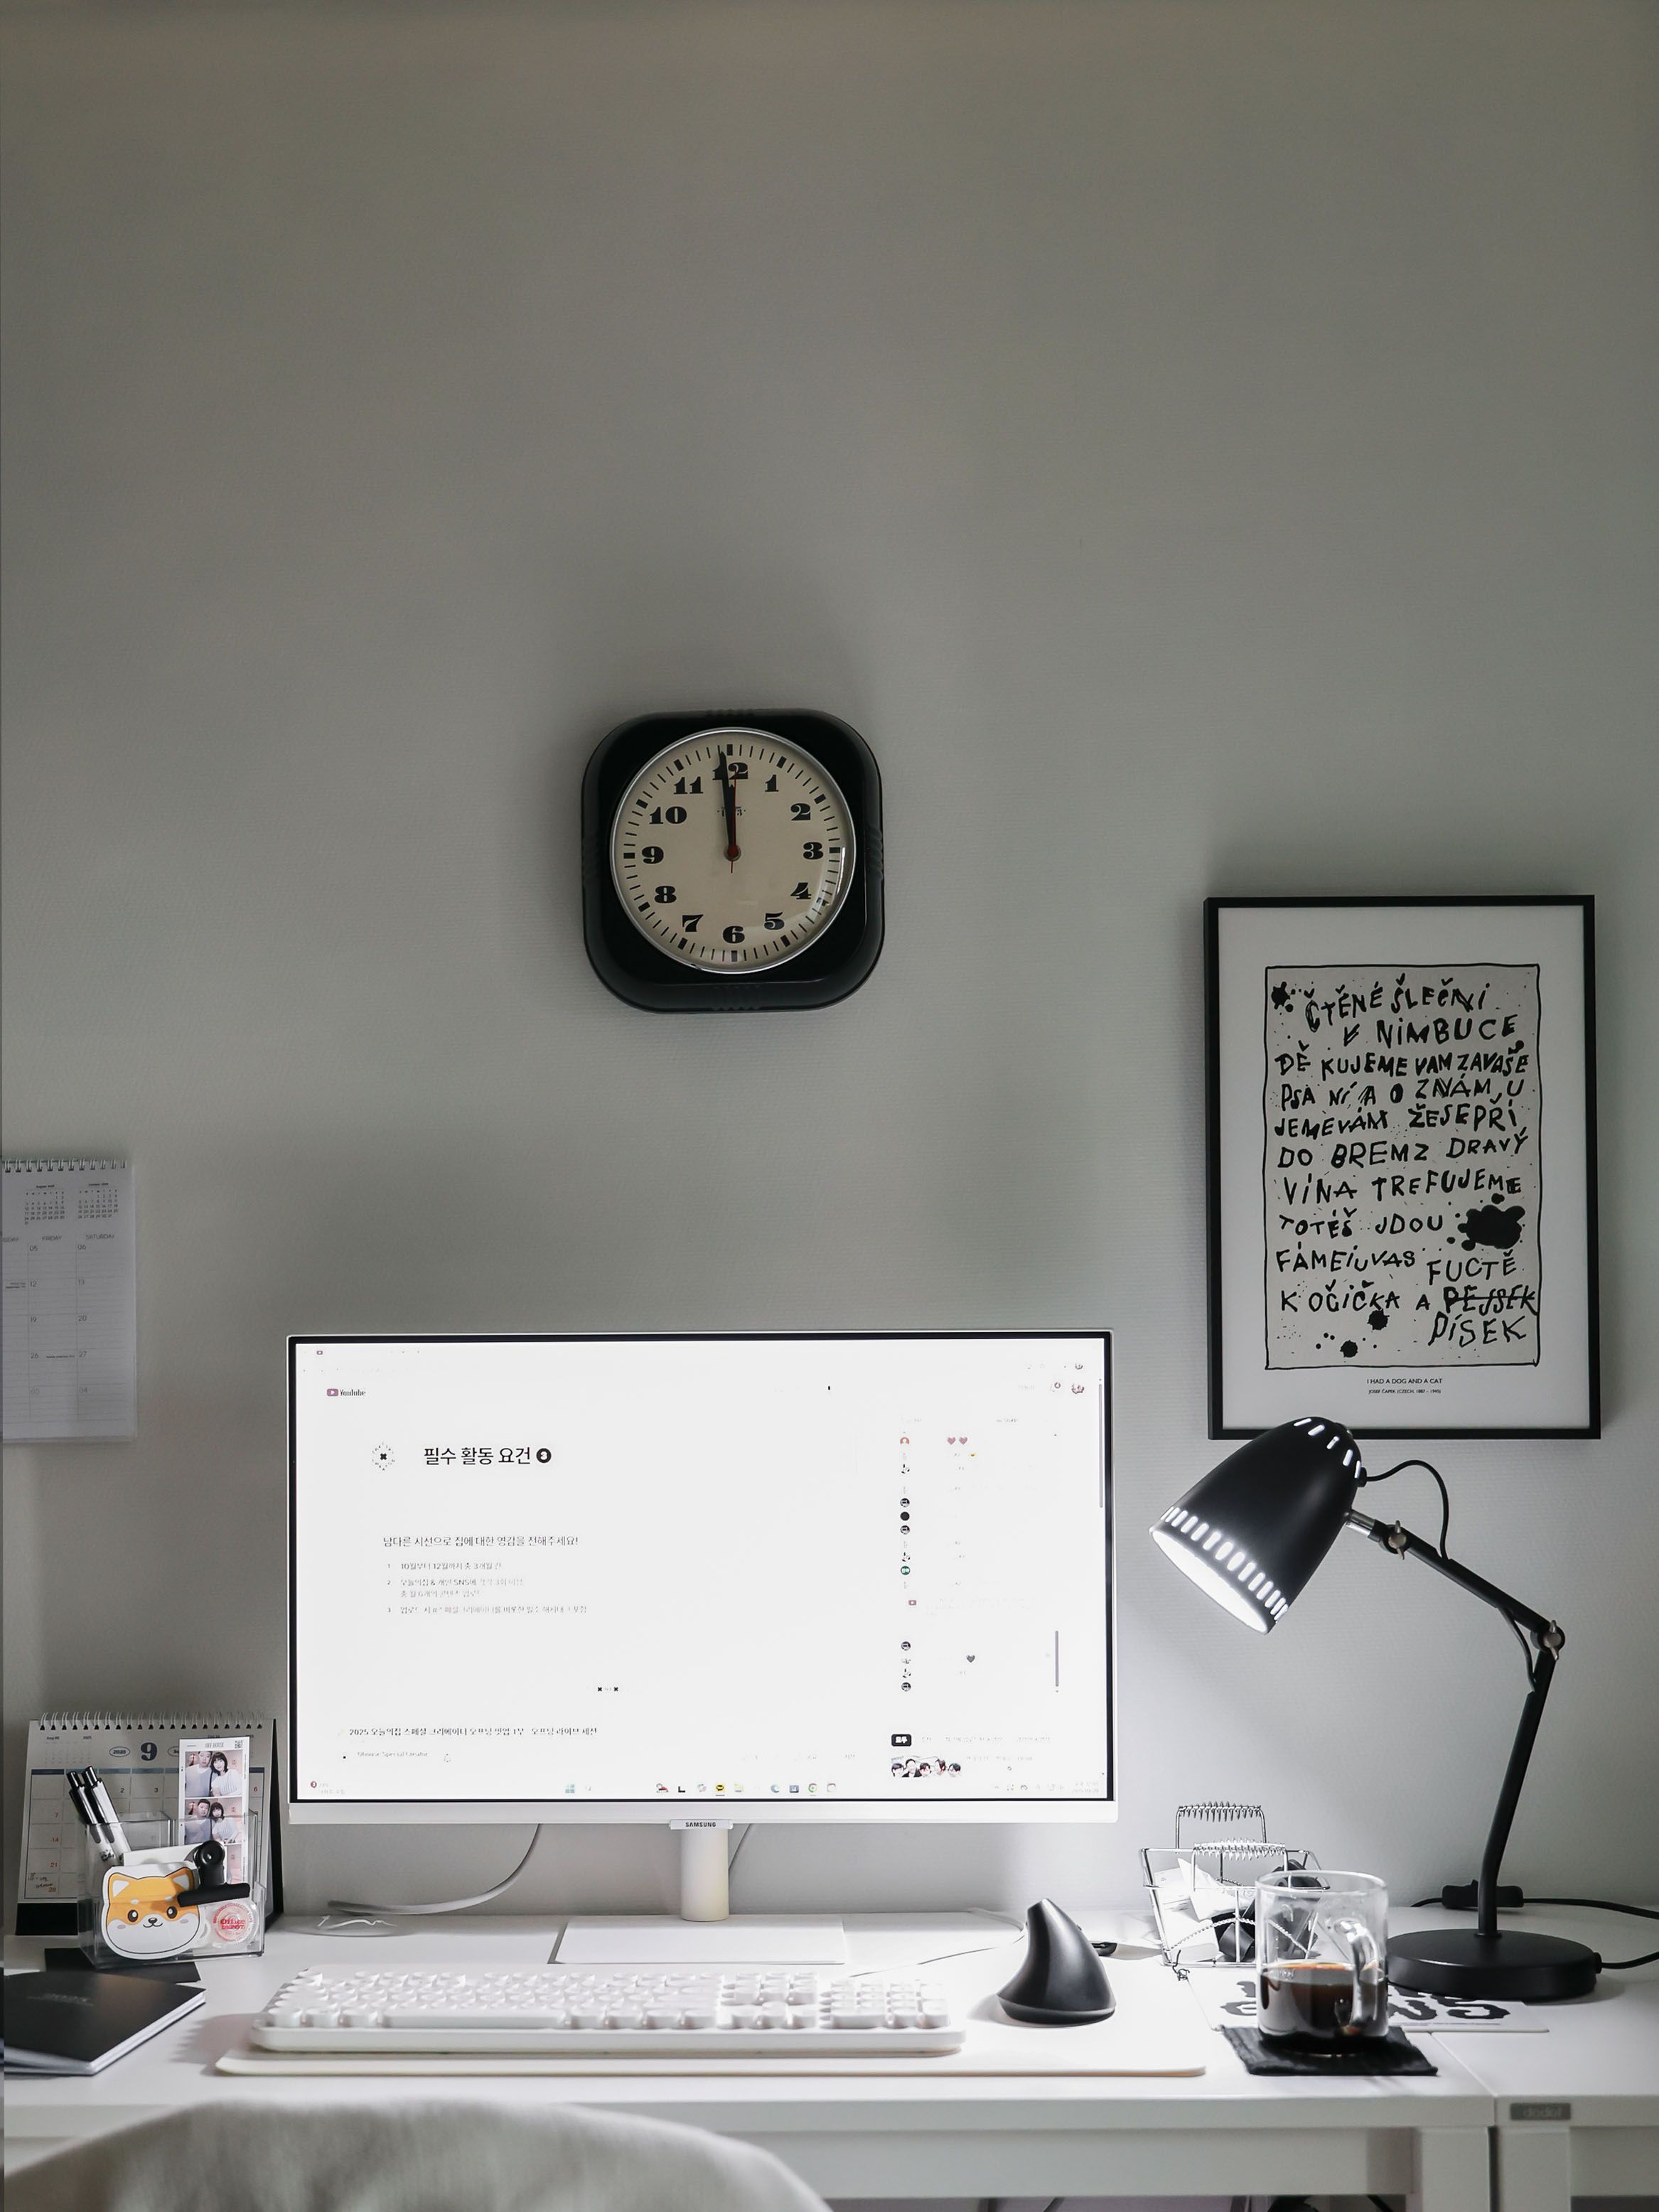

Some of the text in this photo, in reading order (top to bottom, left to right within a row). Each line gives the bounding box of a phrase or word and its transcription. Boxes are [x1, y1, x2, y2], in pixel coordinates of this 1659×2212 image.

[673, 776, 704, 795] 11
[765, 774, 779, 793] 1
[649, 806, 687, 824] 10
[790, 802, 811, 821] 2
[641, 846, 664, 864] 9
[802, 842, 824, 860] 3
[654, 885, 677, 903] 8
[790, 882, 811, 900] 4
[682, 914, 704, 933] 7
[764, 912, 785, 930] 5
[722, 925, 745, 944] 6
[1277, 1147, 1313, 1169] DO
[1375, 1213, 1444, 1235] JDOU
[424, 1447, 456, 1466] 필수
[461, 1447, 493, 1466] 활동
[498, 1447, 531, 1465] 요건
[383, 1536, 579, 1547] 남다른 시선으로 집에 대한 영감을 전해주세요!
[140, 1741, 158, 1761] 9
